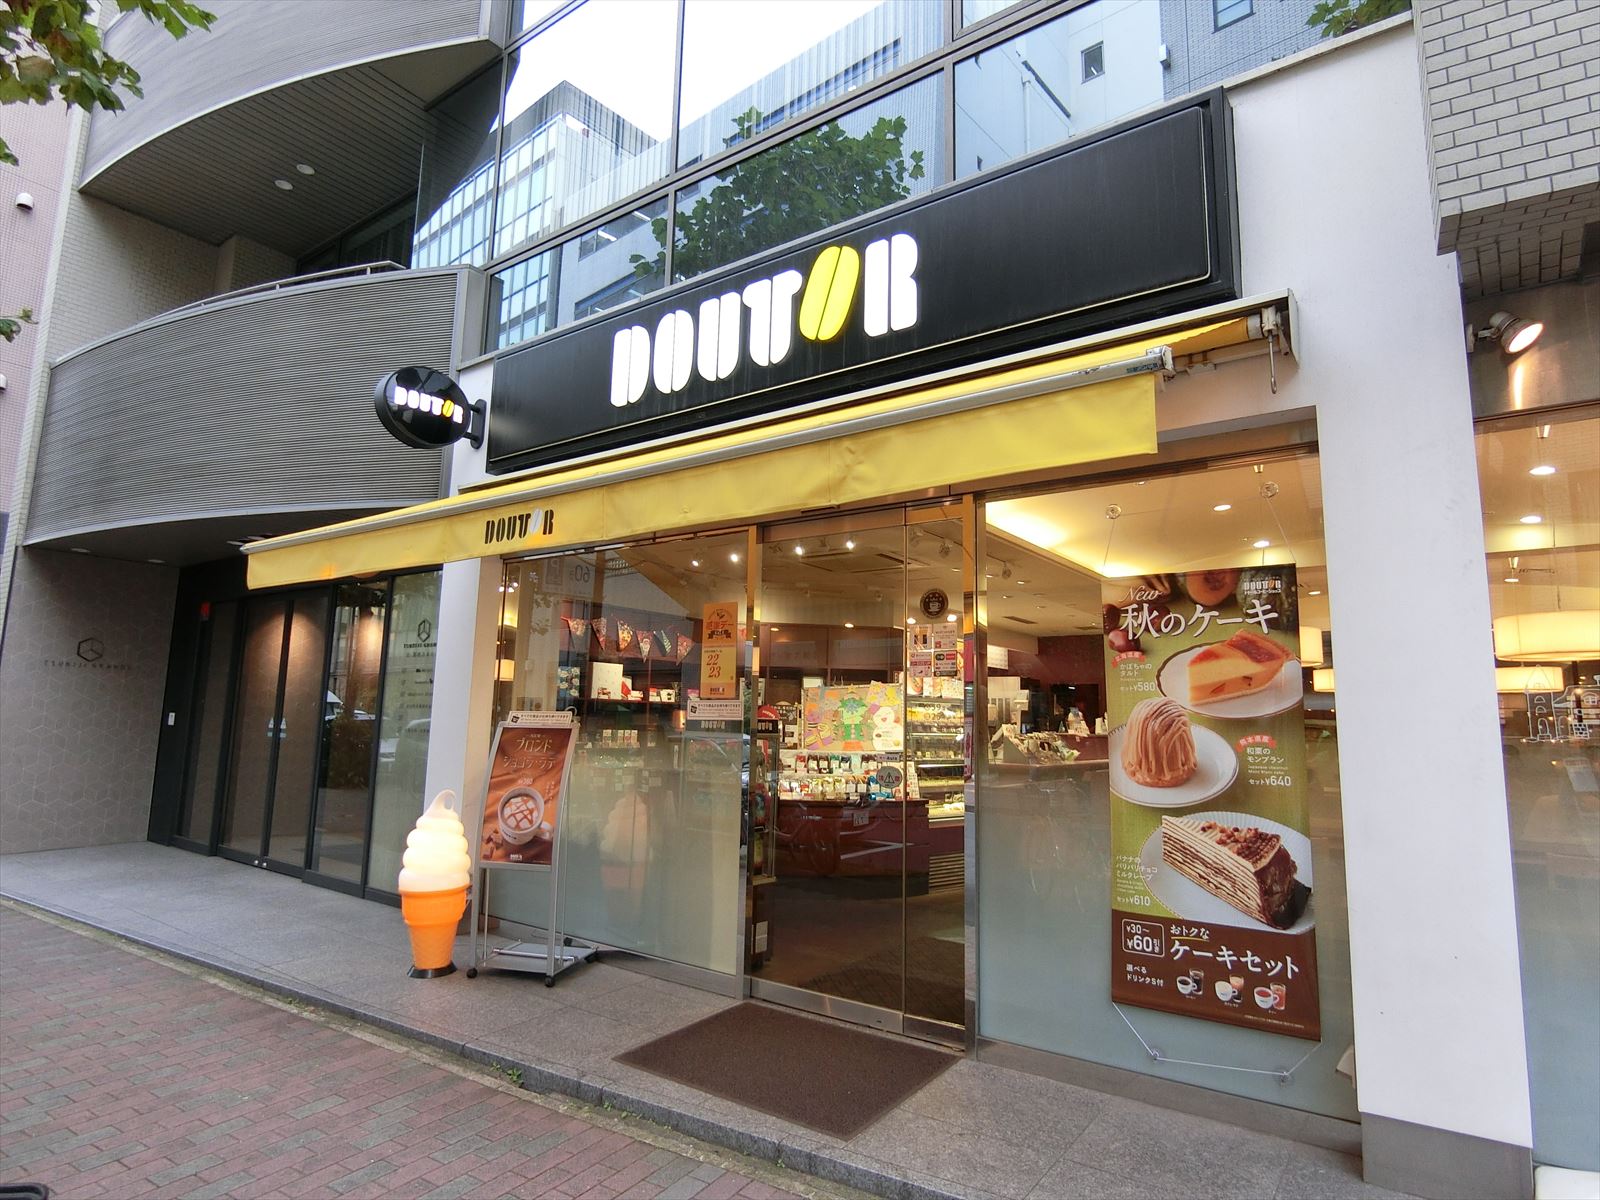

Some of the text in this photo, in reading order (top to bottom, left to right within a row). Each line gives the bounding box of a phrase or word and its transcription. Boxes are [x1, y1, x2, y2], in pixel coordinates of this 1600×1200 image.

[610, 233, 918, 408] DOUTOR
[394, 386, 464, 424] DOUTOR
[485, 508, 554, 544] DOUTOR
[1243, 580, 1281, 590] DOUTOR
[1119, 586, 1162, 602] New
[1120, 600, 1279, 640] 秋のケーキ
[706, 654, 720, 666] 22
[708, 666, 721, 679] 23
[1247, 747, 1270, 755] 和栗の
[1247, 755, 1284, 763] モンブラン
[1116, 870, 1153, 881] ミルクレープ
[1170, 924, 1210, 940] おトクな
[1170, 940, 1299, 979] ケーキセット
